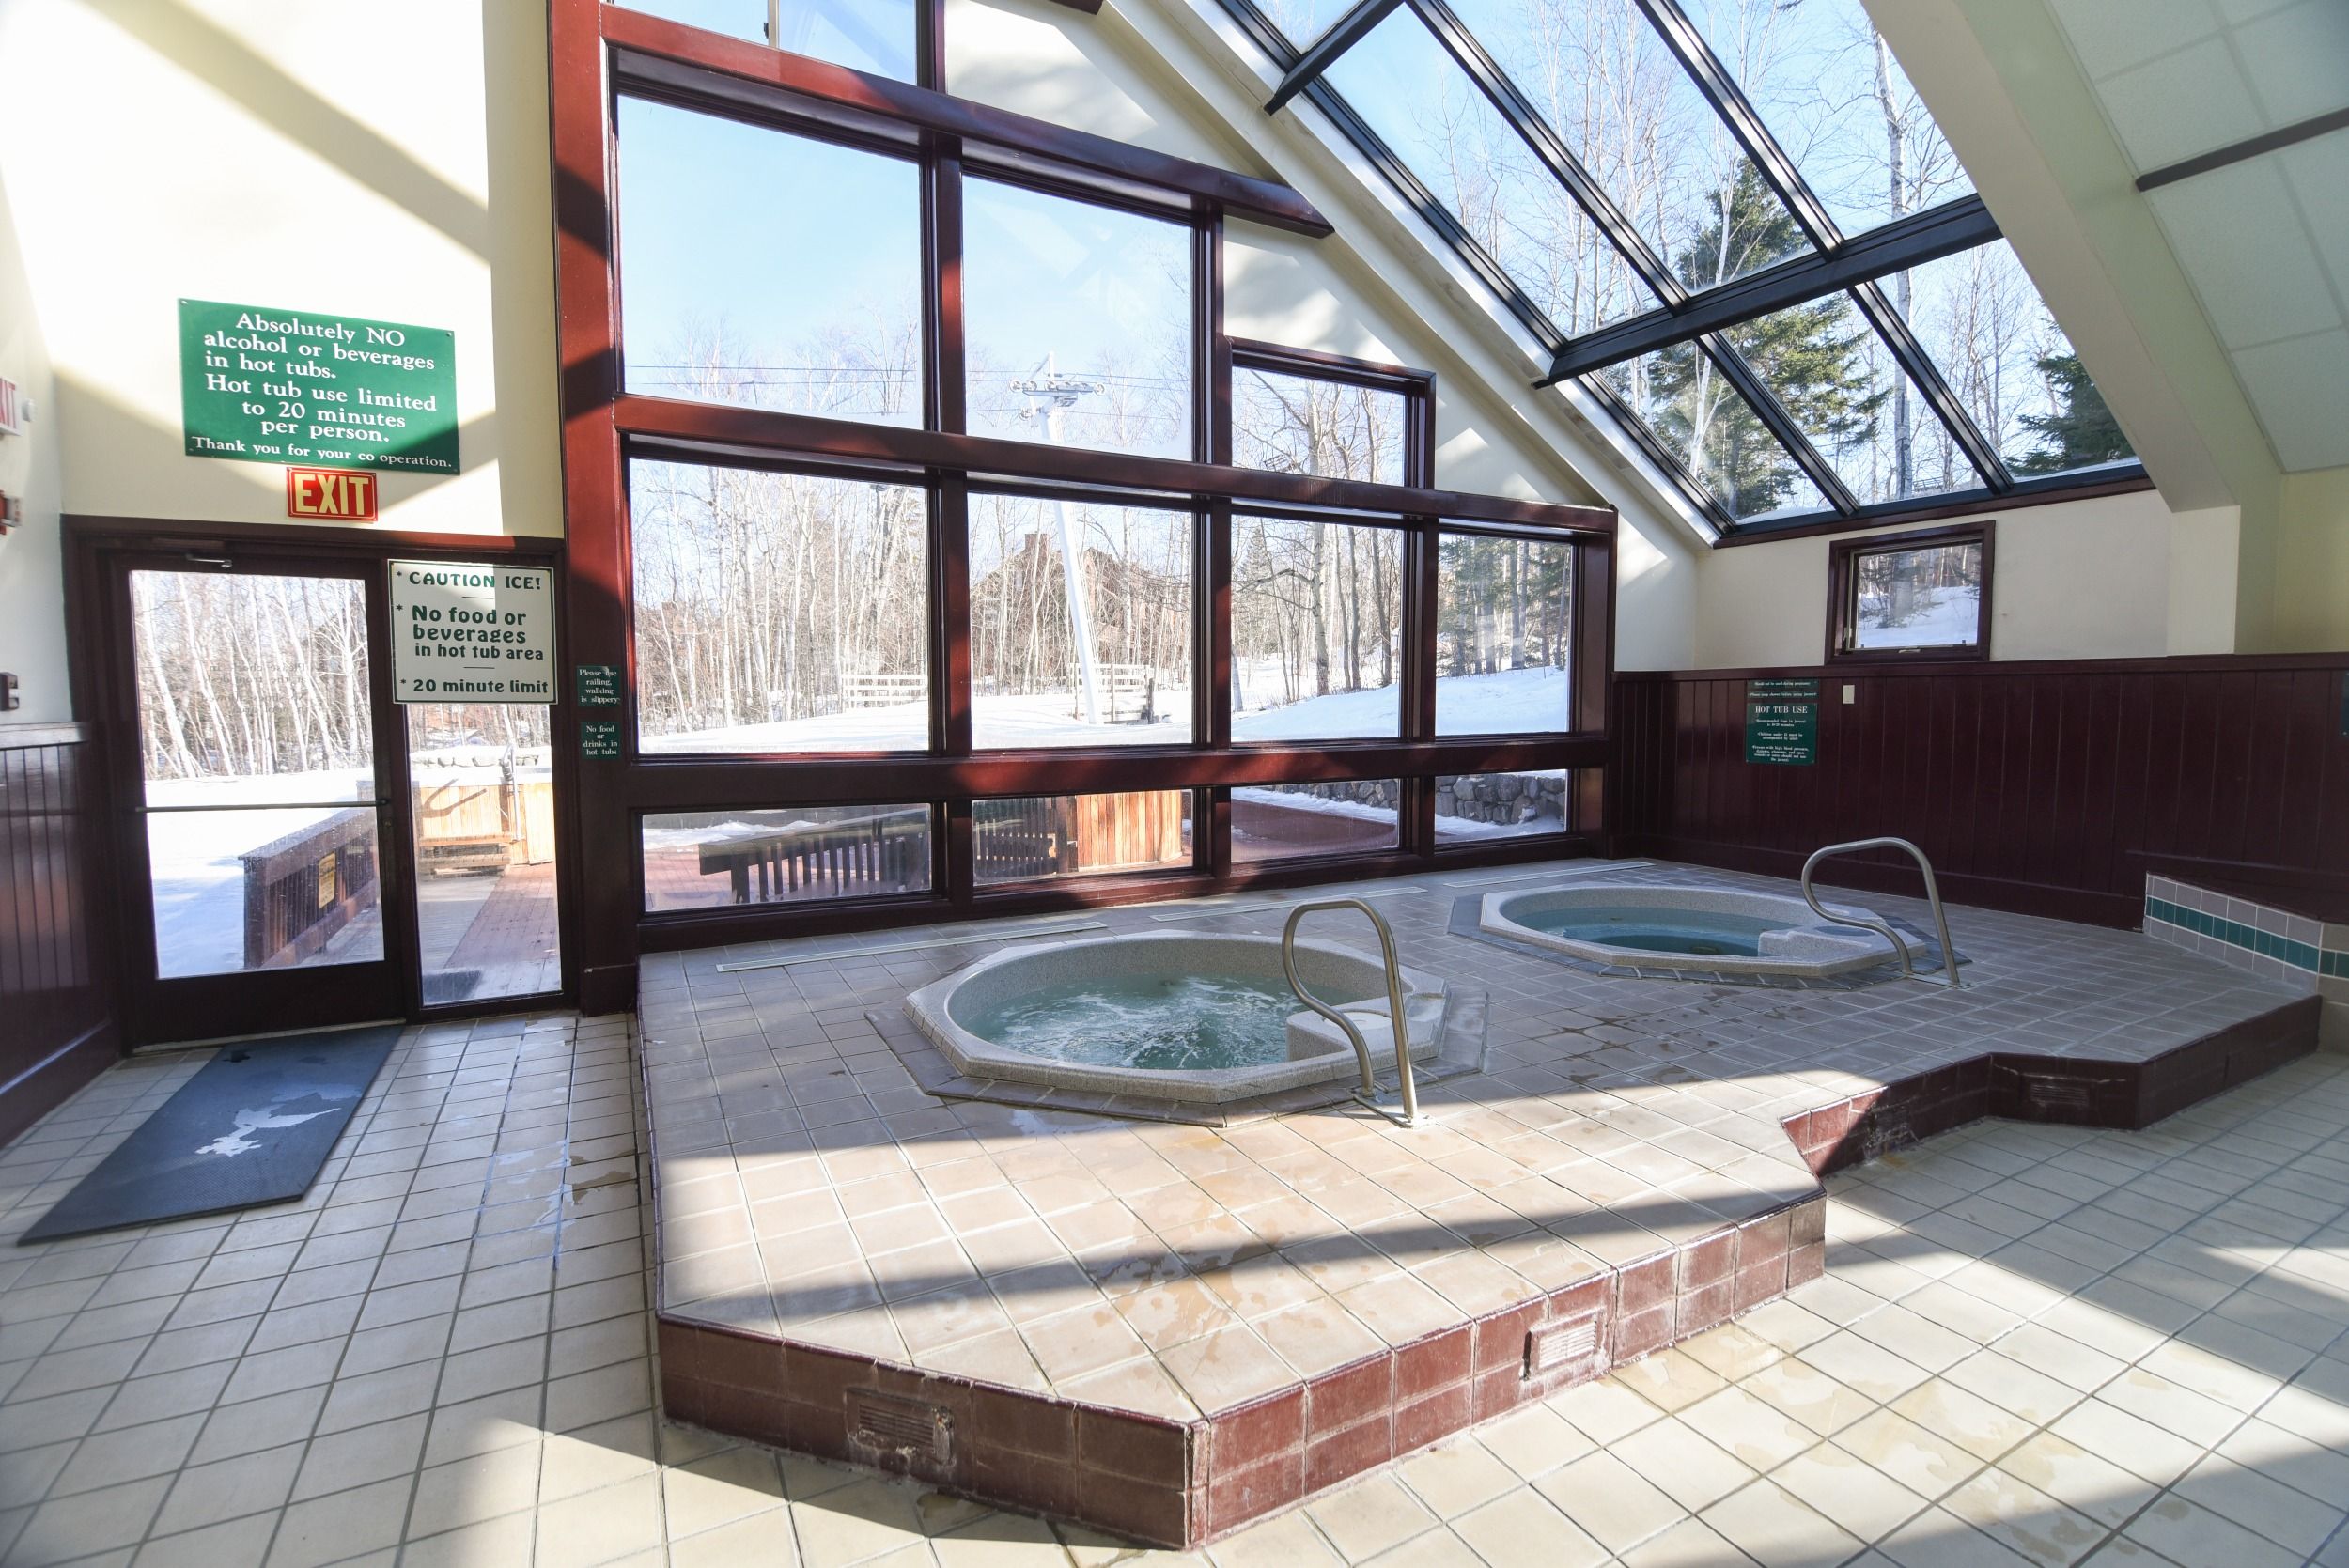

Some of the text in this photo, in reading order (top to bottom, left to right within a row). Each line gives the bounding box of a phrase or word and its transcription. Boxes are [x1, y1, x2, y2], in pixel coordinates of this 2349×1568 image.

[235, 313, 405, 347] Absolutely NO
[204, 330, 435, 371] alcohol or beverages
[205, 350, 336, 379] in hot tubs.
[205, 373, 437, 411] Hot tub use limited
[241, 401, 406, 428] to 20 minutes
[260, 420, 390, 442] per person.
[191, 436, 246, 453] Thank
[252, 444, 281, 456] you
[287, 443, 311, 457] for
[317, 449, 352, 460] your
[294, 473, 369, 516] EXIT
[409, 571, 541, 590] CAUTION ICE!
[412, 605, 527, 626] No food or
[413, 624, 526, 644] beverages
[414, 643, 544, 660] in hot tub area
[579, 668, 602, 676] Please
[413, 679, 549, 694] 20 minute limit
[585, 687, 614, 695] walking
[1755, 706, 1808, 714] HOT TUB USE
[585, 724, 615, 733] No food
[583, 739, 607, 748] drinks
